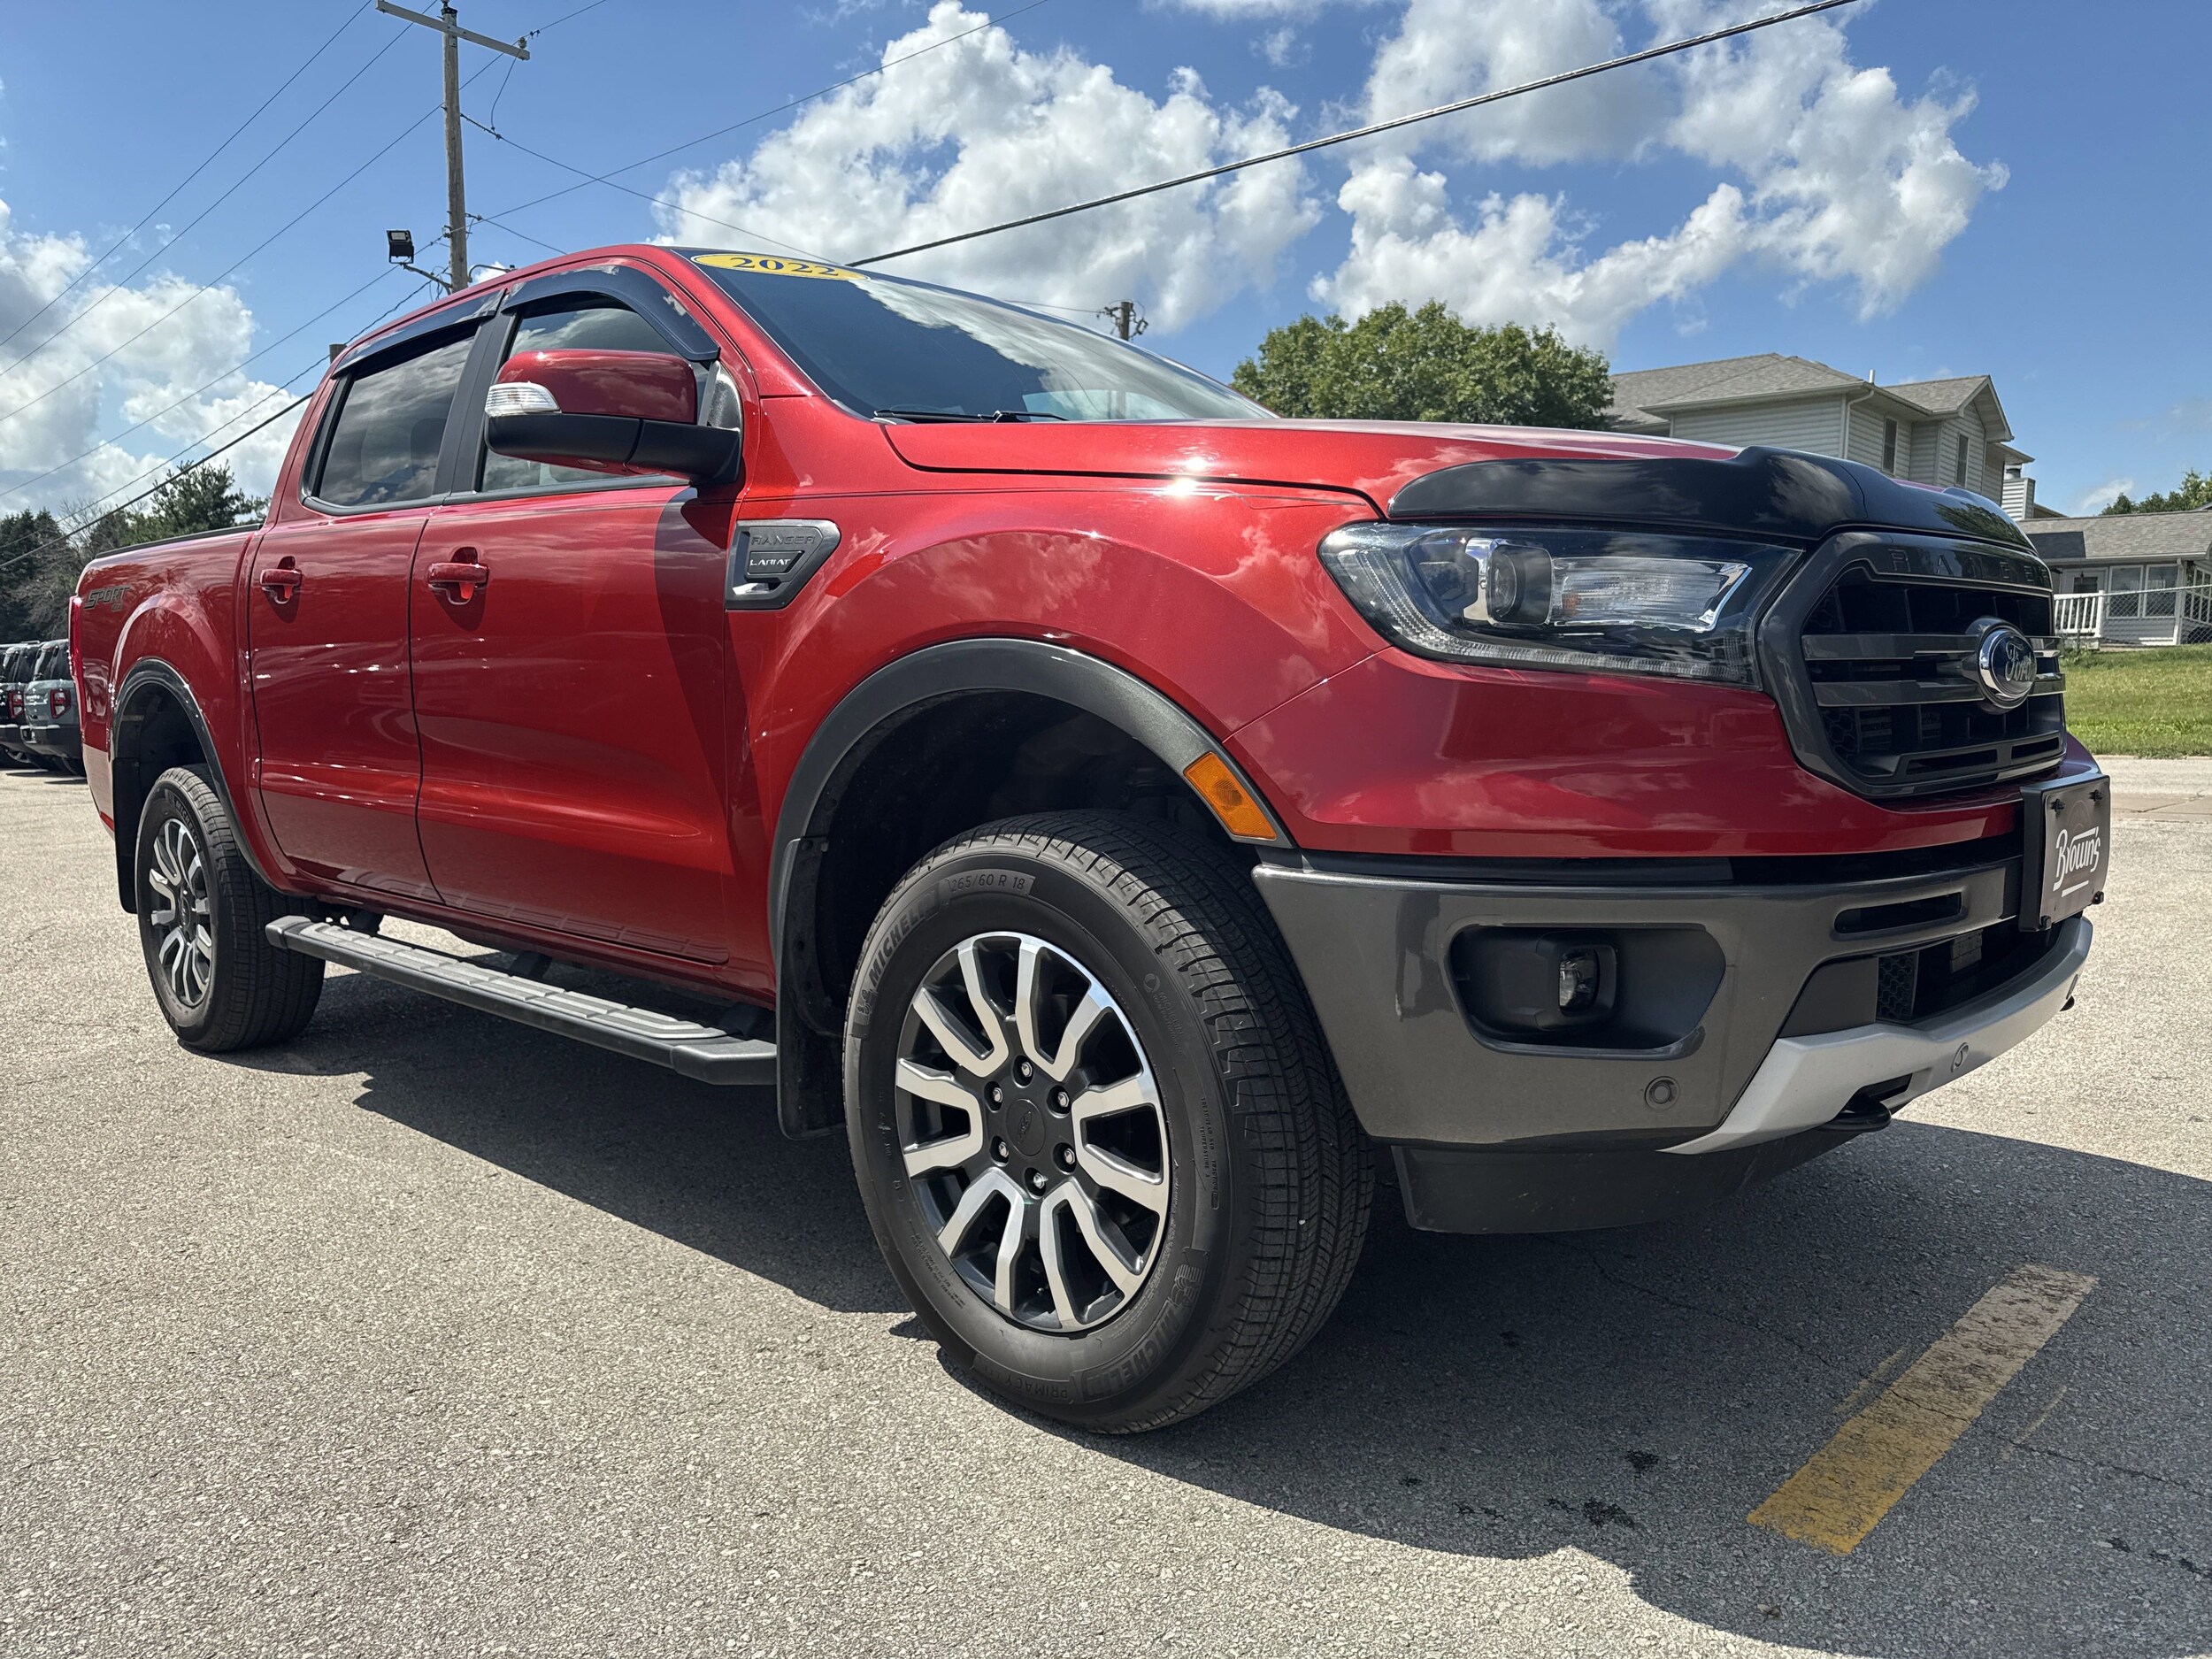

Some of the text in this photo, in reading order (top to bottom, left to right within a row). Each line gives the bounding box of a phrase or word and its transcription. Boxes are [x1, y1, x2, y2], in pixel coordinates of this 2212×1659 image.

[729, 257, 840, 276] 2022
[750, 535, 816, 546] RANGER
[84, 585, 131, 609] SPORT
[2005, 640, 2033, 682] Ford
[2053, 826, 2101, 892] Brown's
[951, 873, 1025, 892] 265/60 R 18
[867, 889, 938, 988] MICHELIN
[1005, 1374, 1069, 1399] PRIMACY
